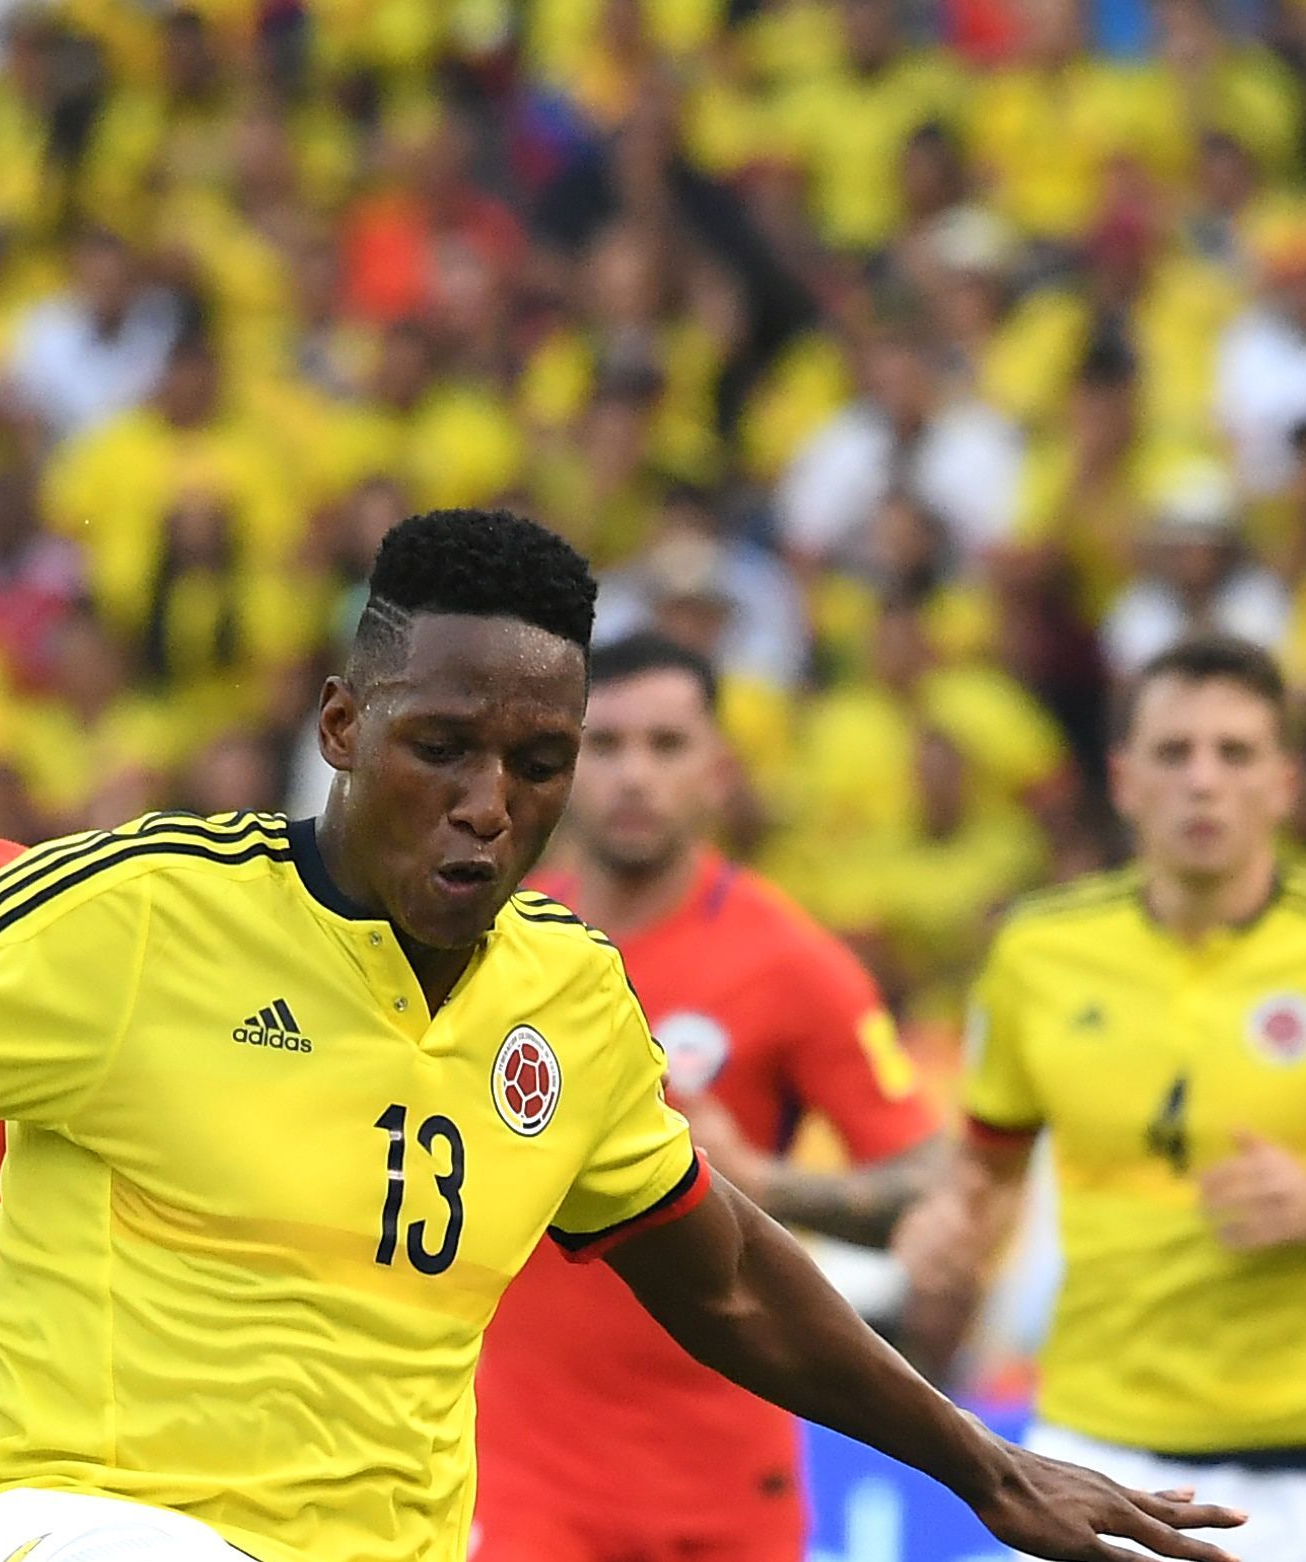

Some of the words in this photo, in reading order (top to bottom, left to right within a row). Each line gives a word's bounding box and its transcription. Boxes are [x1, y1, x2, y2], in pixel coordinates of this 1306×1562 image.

[233, 1027, 312, 1053] adidas
[1145, 1070, 1190, 1174] 4
[374, 1104, 464, 1275] 13
